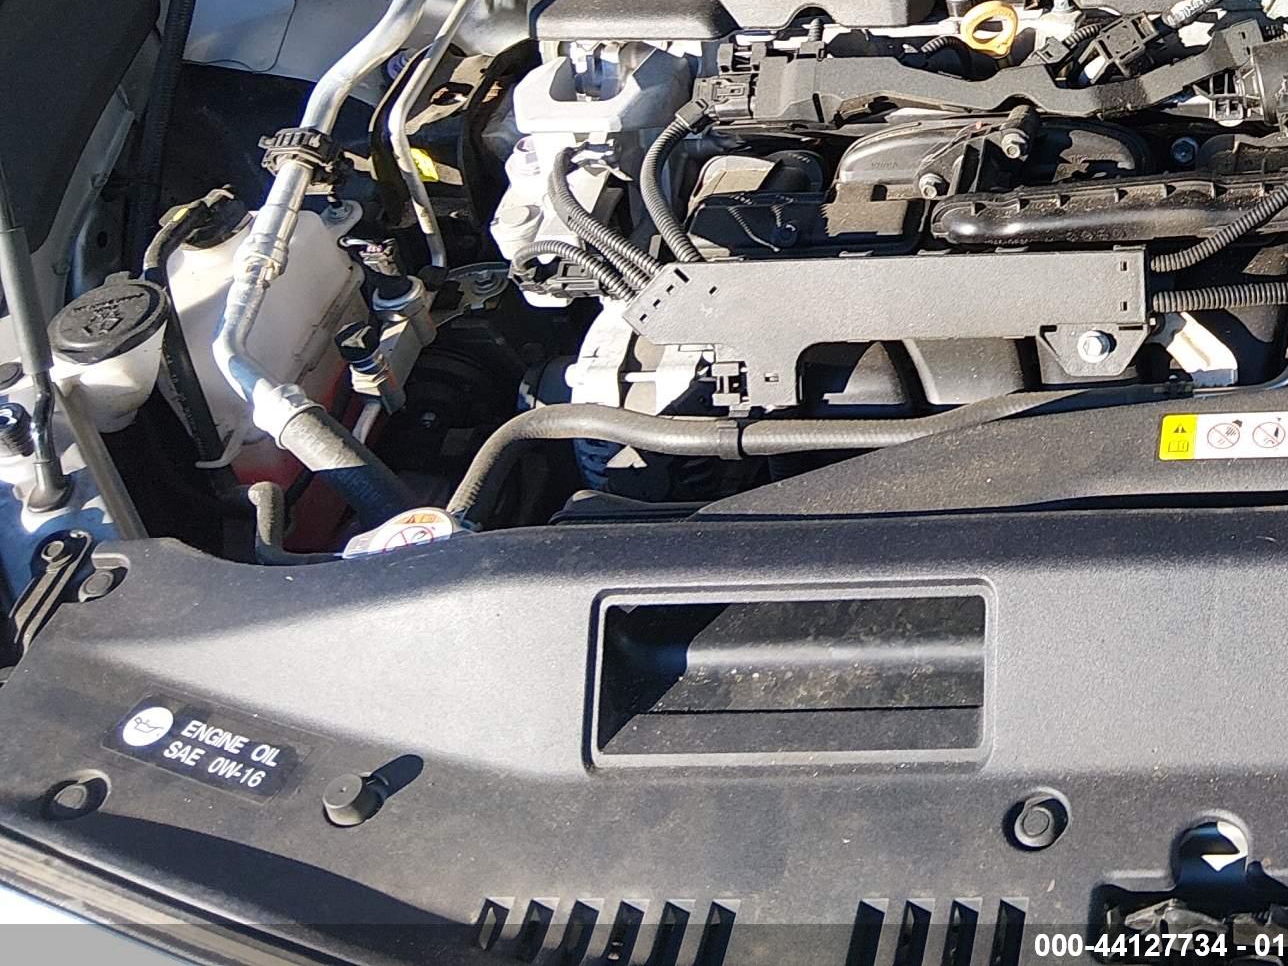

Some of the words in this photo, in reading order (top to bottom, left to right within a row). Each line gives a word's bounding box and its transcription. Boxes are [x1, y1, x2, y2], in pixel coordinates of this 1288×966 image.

[163, 741, 205, 766] SAE
[207, 756, 266, 787] 0W-16
[181, 720, 249, 754] ENGINE
[251, 744, 280, 767] OIL
